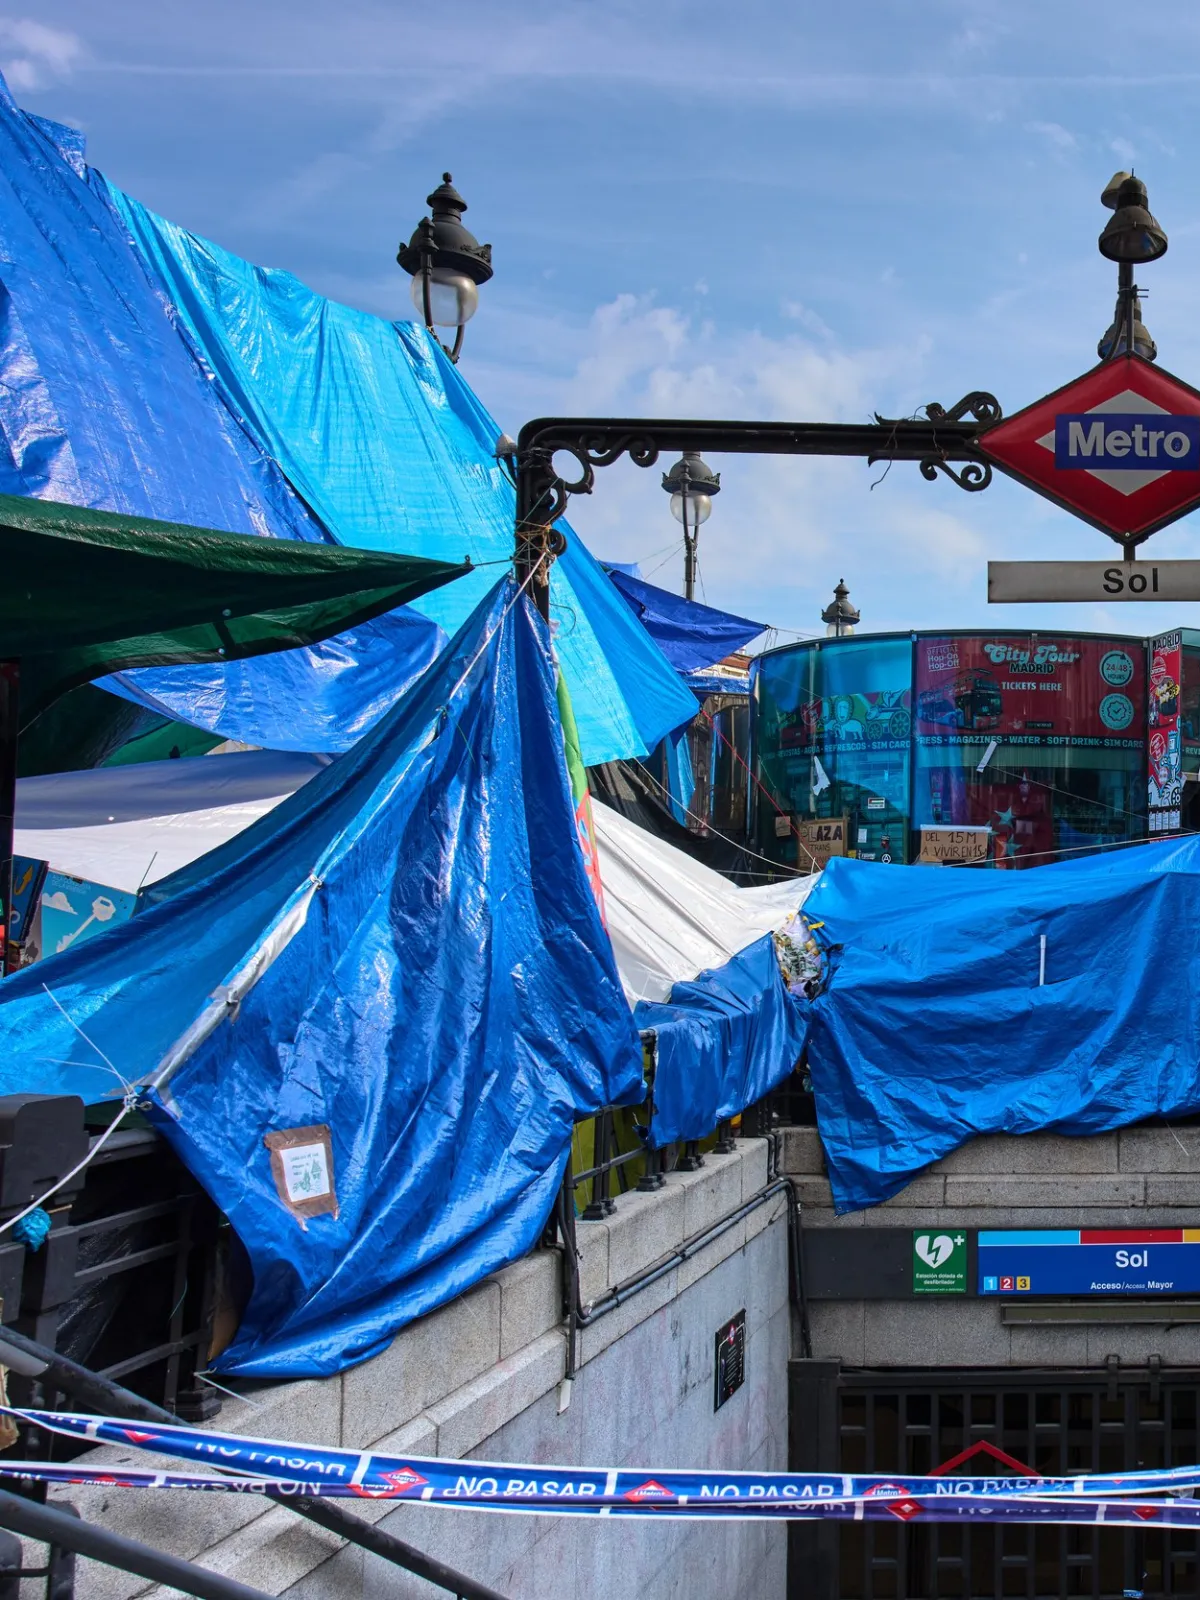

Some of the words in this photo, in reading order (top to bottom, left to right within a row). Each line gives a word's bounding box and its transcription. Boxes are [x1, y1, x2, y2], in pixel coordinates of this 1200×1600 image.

[1067, 420, 1191, 460] Metro
[1103, 567, 1160, 596] Sol
[928, 653, 959, 662] Hop-On
[984, 643, 1030, 665] City
[1033, 644, 1080, 664] Tour
[928, 660, 960, 670] Hop-Off
[1009, 662, 1054, 674] MADRID
[1001, 681, 1037, 690] TICKETS
[1039, 682, 1062, 691] HERE
[950, 735, 1002, 744] MAGAZINES
[1009, 736, 1040, 744] WATER
[1047, 736, 1070, 745] SOFT
[1071, 737, 1099, 746] DRINK
[1104, 738, 1121, 747] SIM
[824, 743, 867, 752] REFRESCOS
[871, 742, 887, 750] SIM
[925, 832, 940, 842] DEL
[808, 843, 831, 852] TRANS
[921, 846, 929, 856] A
[962, 846, 972, 857] EN
[1115, 1250, 1148, 1268] Sol
[1003, 1279, 1011, 1289] 2
[1019, 1278, 1027, 1289] 3
[1147, 1280, 1174, 1290] Mayor
[455, 1476, 498, 1495] NO
[506, 1479, 596, 1497] PASAR
